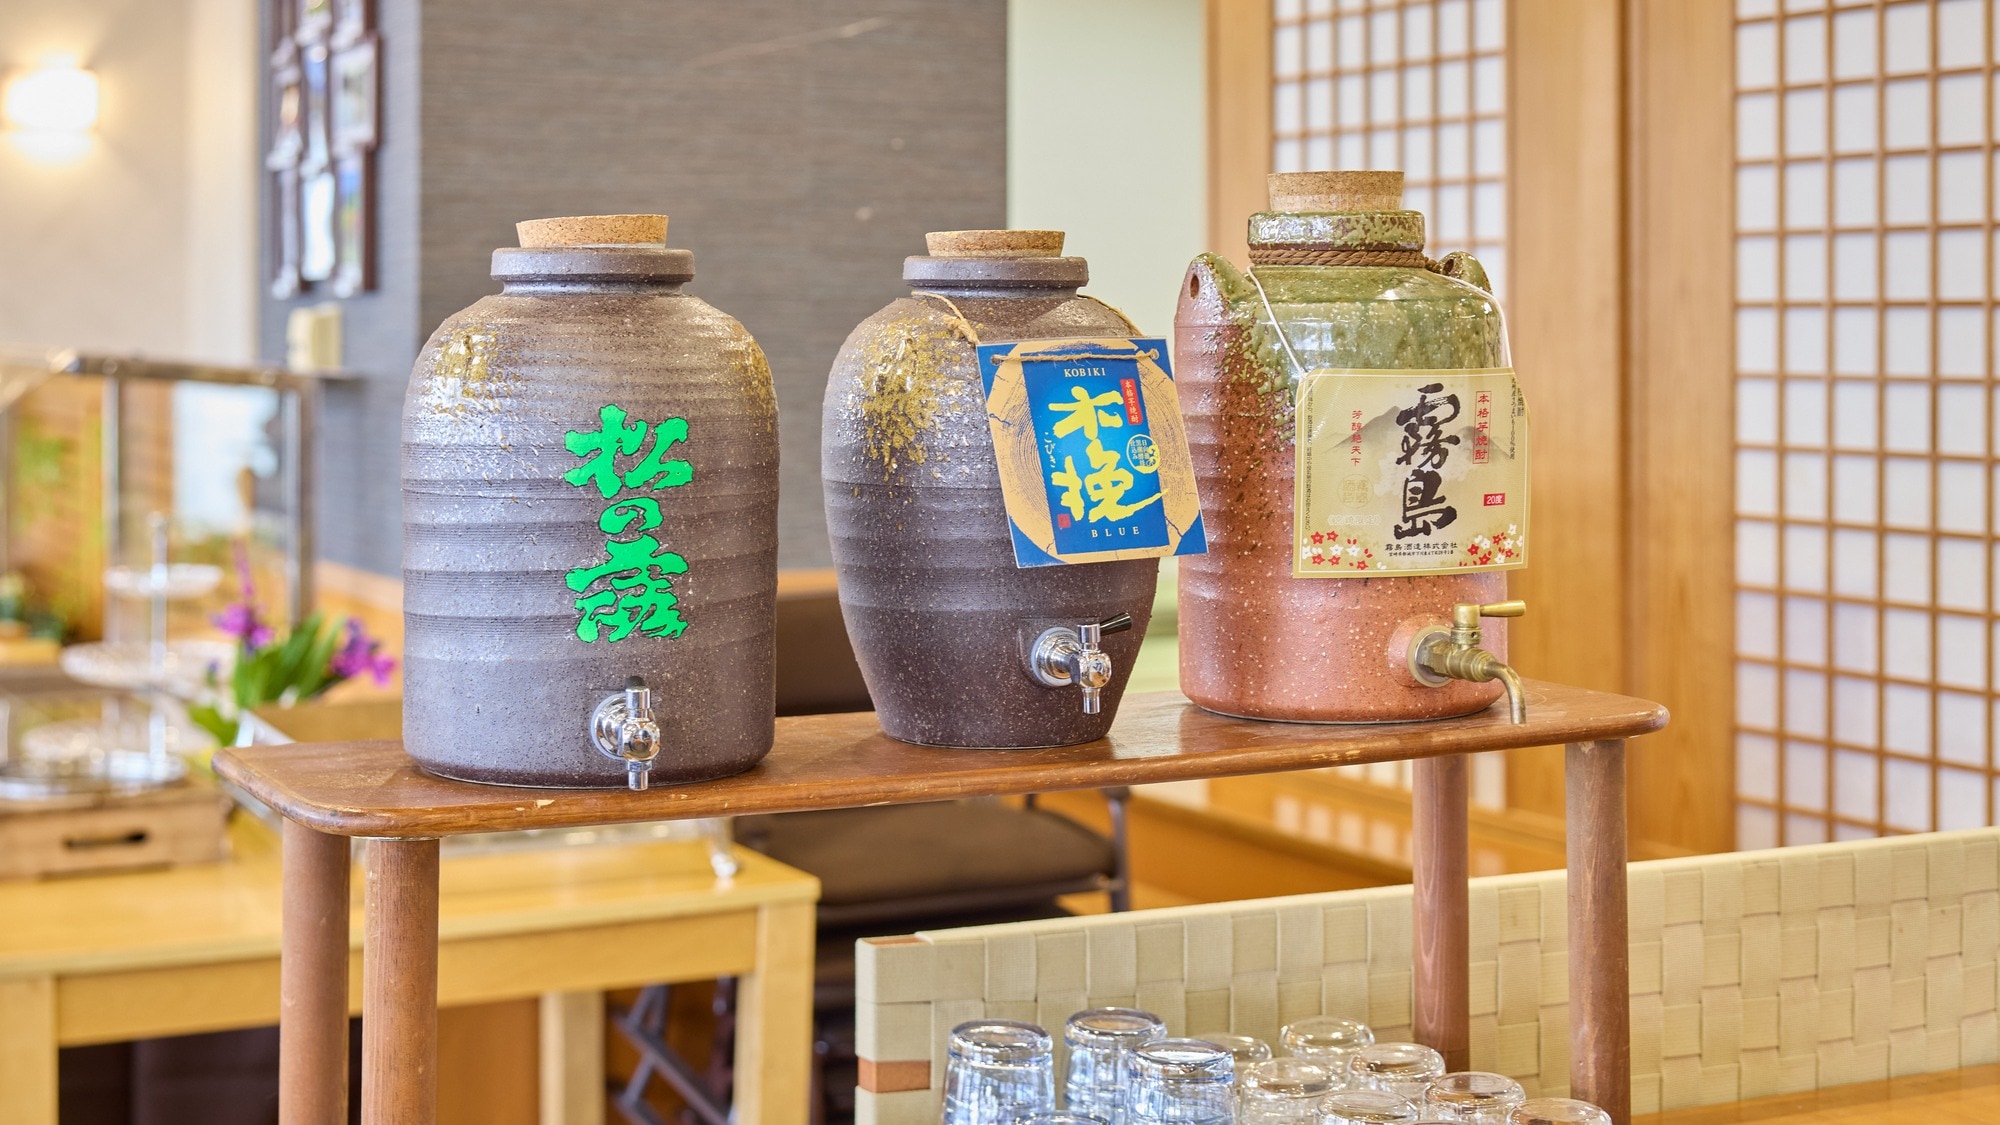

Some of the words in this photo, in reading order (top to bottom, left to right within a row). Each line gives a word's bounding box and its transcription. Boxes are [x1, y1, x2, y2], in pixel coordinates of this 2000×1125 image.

[1063, 367, 1107, 378] KOBIKI
[1125, 380, 1139, 423] 本格芋焼酎
[1475, 394, 1489, 460] 本格芋焼酎
[1048, 385, 1169, 523] 木挽
[1394, 382, 1461, 540] 霧島
[1486, 494, 1503, 505] 20度
[563, 403, 694, 643] 松の露
[1091, 525, 1140, 538] BLUE
[1385, 541, 1458, 551] 霧島酒造株式会社
